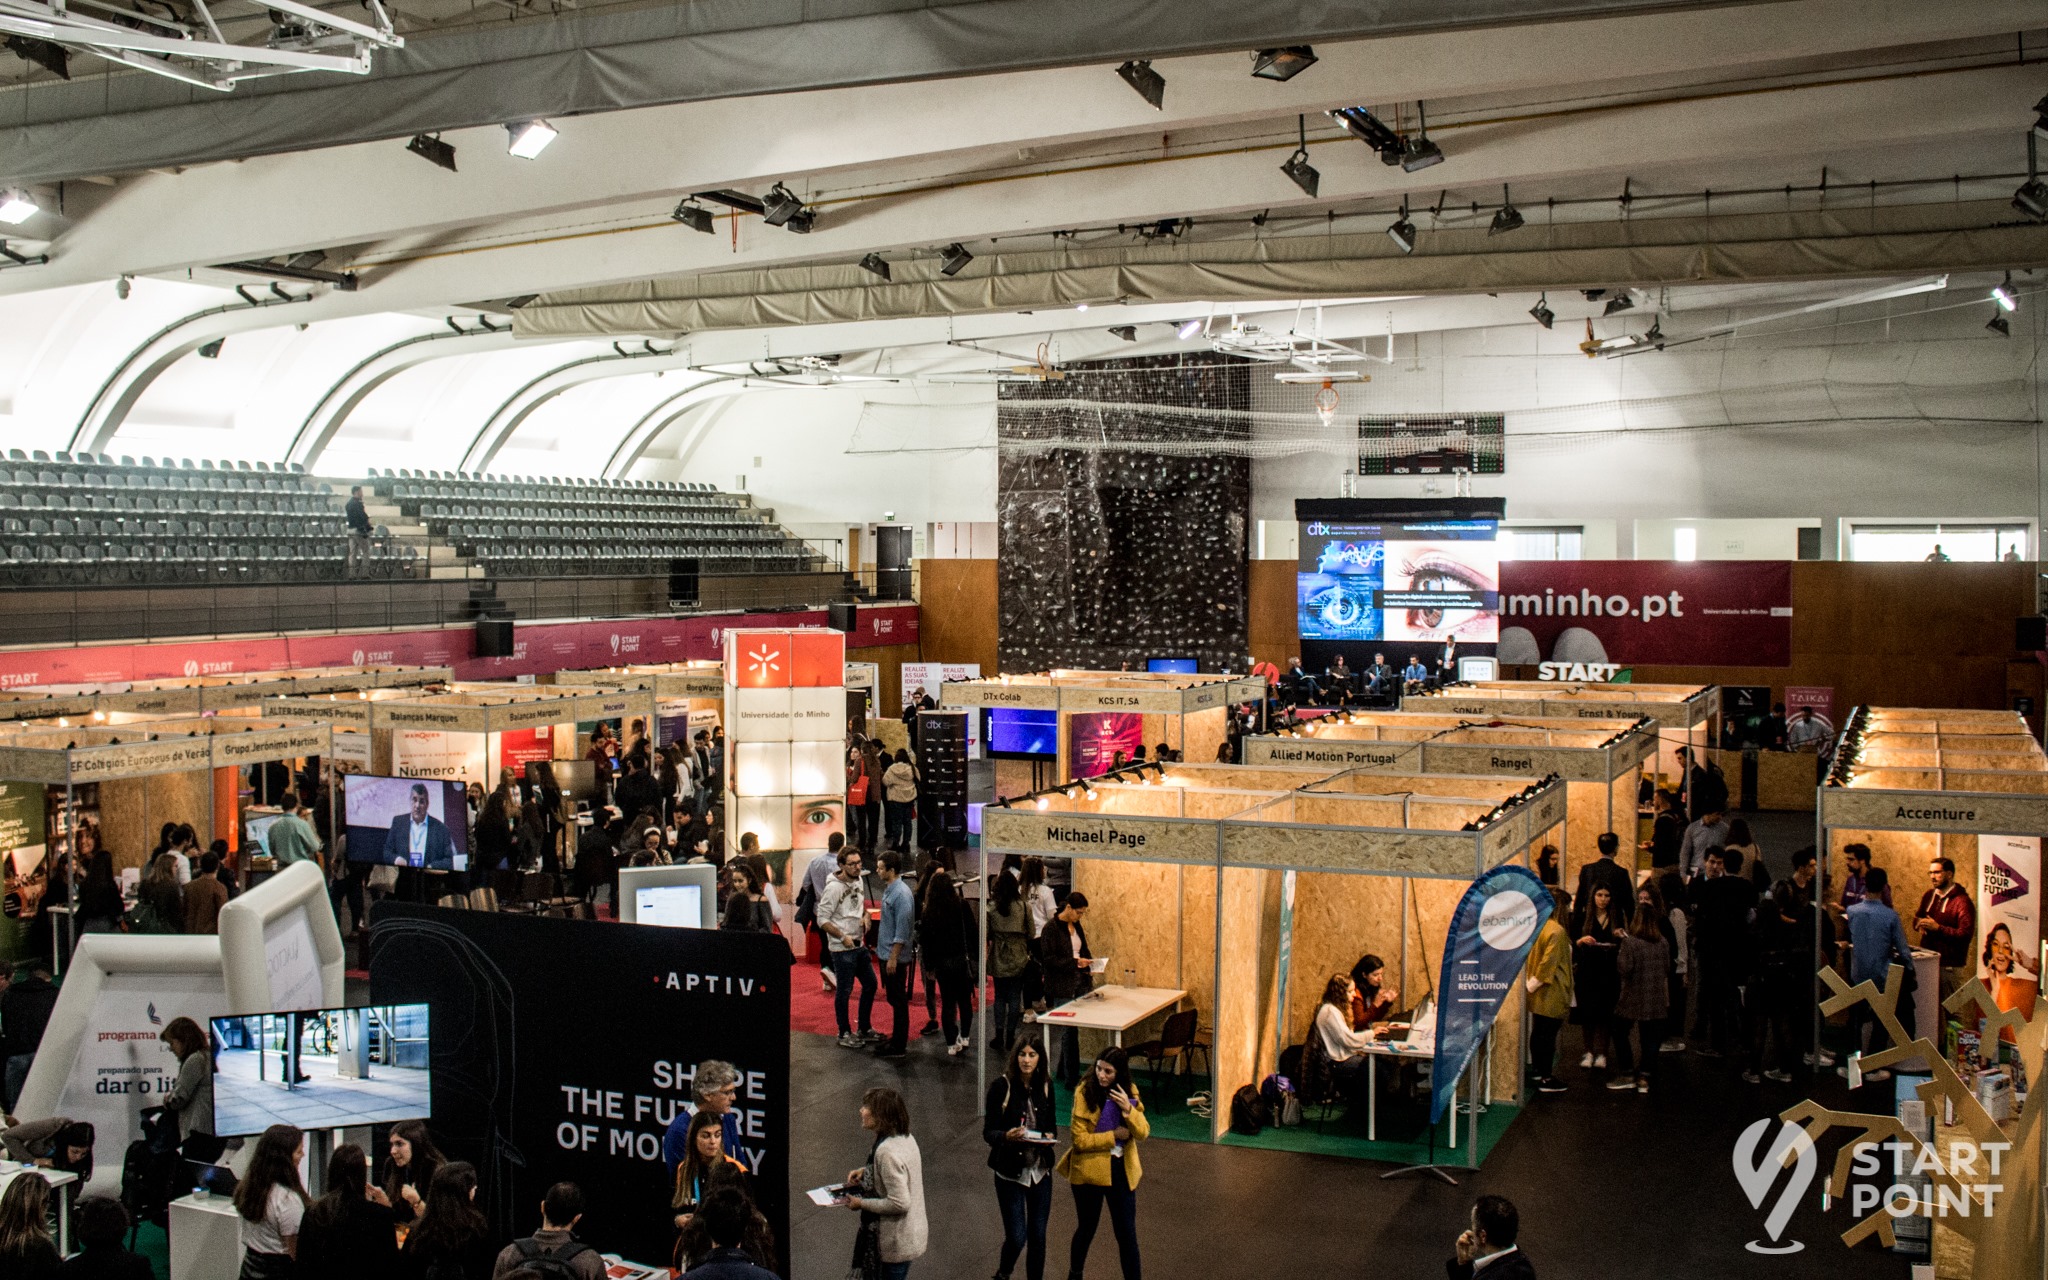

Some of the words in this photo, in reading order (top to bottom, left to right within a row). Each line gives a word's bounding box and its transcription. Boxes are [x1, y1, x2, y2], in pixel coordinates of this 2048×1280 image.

[880, 619, 893, 627] START
[621, 635, 640, 644] START
[513, 642, 527, 651] ART
[621, 643, 640, 652] POINT
[367, 650, 395, 662] START
[202, 661, 234, 674] START
[1537, 661, 1621, 682] START
[0, 672, 39, 686] START
[686, 684, 724, 692] BorgWarne
[983, 692, 998, 701] DTx
[999, 692, 1021, 702] Colab
[1098, 696, 1115, 705] KCS
[1116, 697, 1127, 706] IT,
[1128, 697, 1140, 706] SA
[269, 707, 292, 716] ALTER
[292, 708, 334, 718] SOLUTIONS
[335, 708, 366, 720] Portugal
[390, 712, 425, 723] Balanças
[425, 713, 459, 724] Marques
[537, 708, 562, 719] Marques
[740, 711, 790, 719] Universidade
[1578, 709, 1604, 718] Ernst
[1606, 710, 1613, 718] &
[1615, 710, 1646, 719] Young
[925, 720, 942, 729] dtx
[225, 743, 249, 757] Grupo
[251, 739, 288, 752] Jerónimo
[290, 736, 319, 749] Martins
[70, 760, 82, 773] EF
[85, 756, 125, 771] Colégios
[128, 754, 171, 768] Europeus
[172, 750, 183, 761] de
[185, 747, 211, 760] Verão
[1269, 749, 1302, 761] Allied
[1305, 751, 1344, 762] Motion
[1346, 752, 1397, 765] Portugal
[1491, 757, 1533, 771] Rangel
[400, 765, 456, 777] Número
[460, 765, 468, 775] 1
[1896, 805, 1976, 821] Accenture
[1046, 826, 1105, 844] Michael
[1108, 829, 1147, 849] Page
[2007, 842, 2031, 850] accenture
[1984, 864, 2012, 878] BUILD
[1984, 874, 2010, 888] YOUR
[1983, 884, 2018, 900] FUTURE
[1458, 973, 1479, 982] LEAD
[1480, 973, 1495, 982] THE
[665, 971, 755, 997] APTIV
[1457, 982, 1509, 991] REVOLUTION
[97, 1031, 157, 1042] programa
[97, 1067, 142, 1076] preparado
[143, 1067, 163, 1075] para
[96, 1078, 132, 1094] dar
[138, 1080, 151, 1094] o
[653, 1060, 766, 1100] SHE
[560, 1085, 625, 1120] THE
[635, 1095, 766, 1139] FUTRE
[557, 1121, 599, 1152] OF
